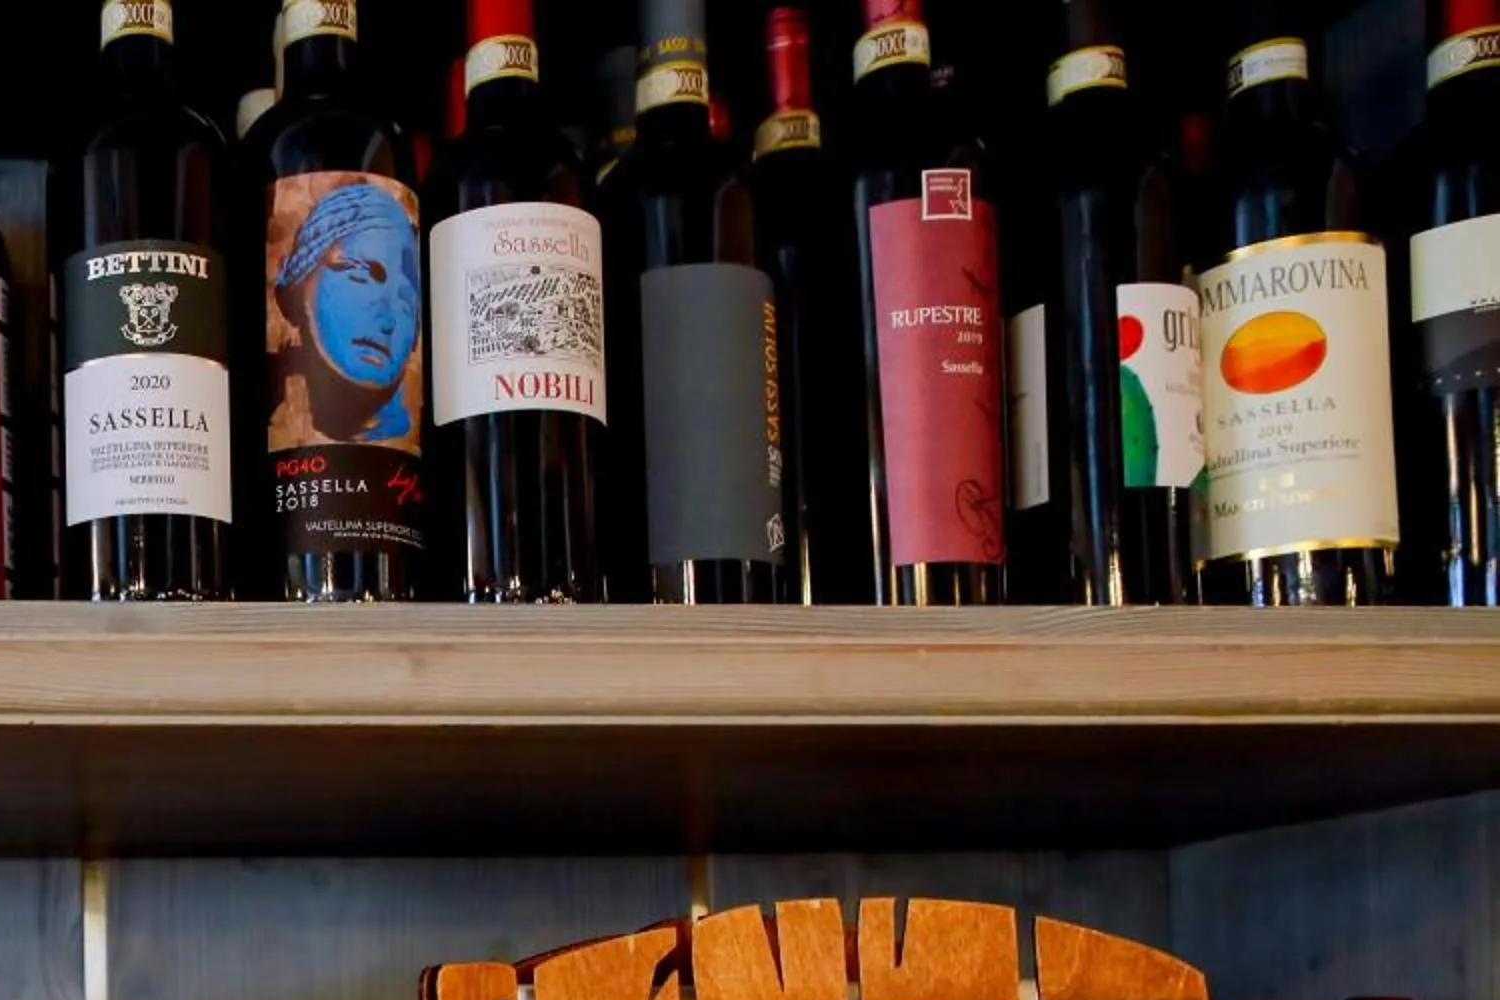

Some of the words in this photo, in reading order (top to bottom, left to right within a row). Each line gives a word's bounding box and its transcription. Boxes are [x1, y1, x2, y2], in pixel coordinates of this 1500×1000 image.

[86, 251, 210, 281] BETTINI
[891, 304, 985, 329] RUPESTRE
[130, 374, 171, 392] 2020
[494, 370, 595, 406] NOBILI
[89, 406, 211, 435] SASSELLA
[1216, 396, 1338, 431] SASSELLA
[275, 479, 370, 499] SASSELLA
[275, 493, 321, 513] 2018
